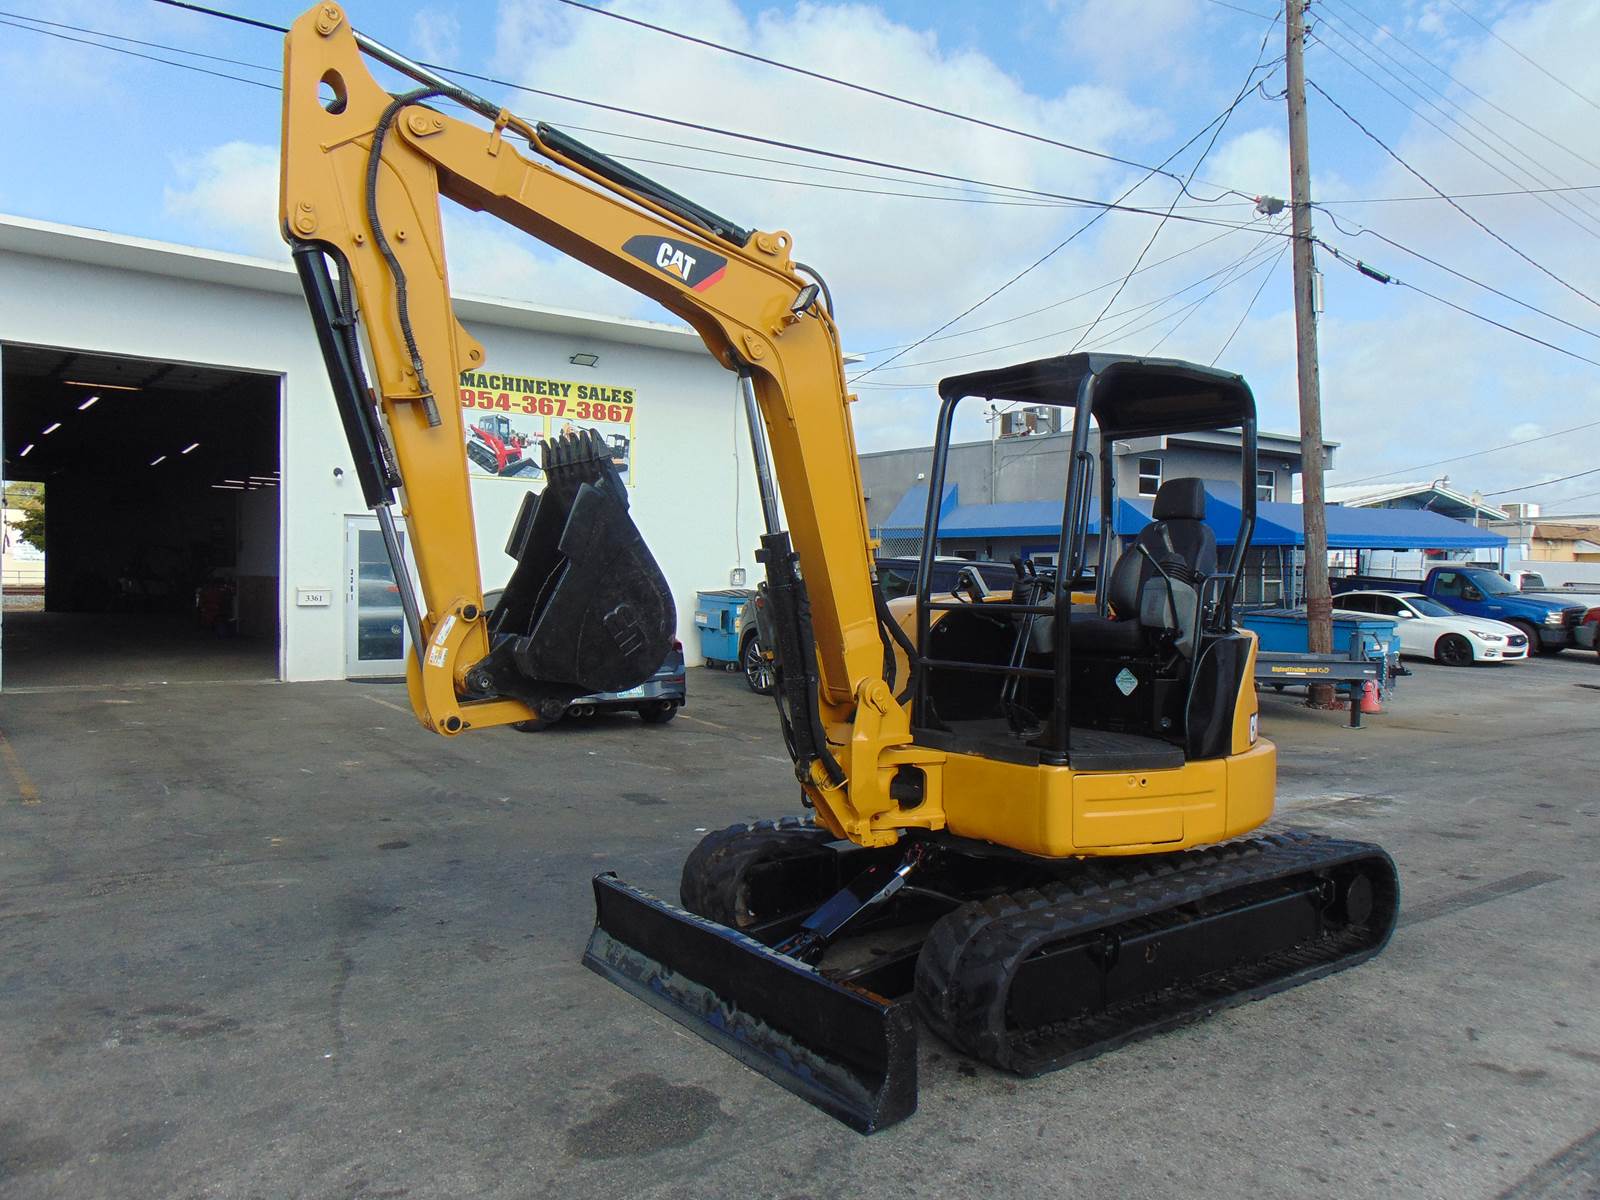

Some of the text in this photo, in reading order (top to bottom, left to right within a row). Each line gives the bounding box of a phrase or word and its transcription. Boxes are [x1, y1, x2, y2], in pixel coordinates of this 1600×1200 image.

[656, 242, 697, 281] CAT
[460, 372, 633, 404] MACHINERY SALES
[460, 388, 633, 423] 954-367-3867
[304, 594, 323, 602] 3361
